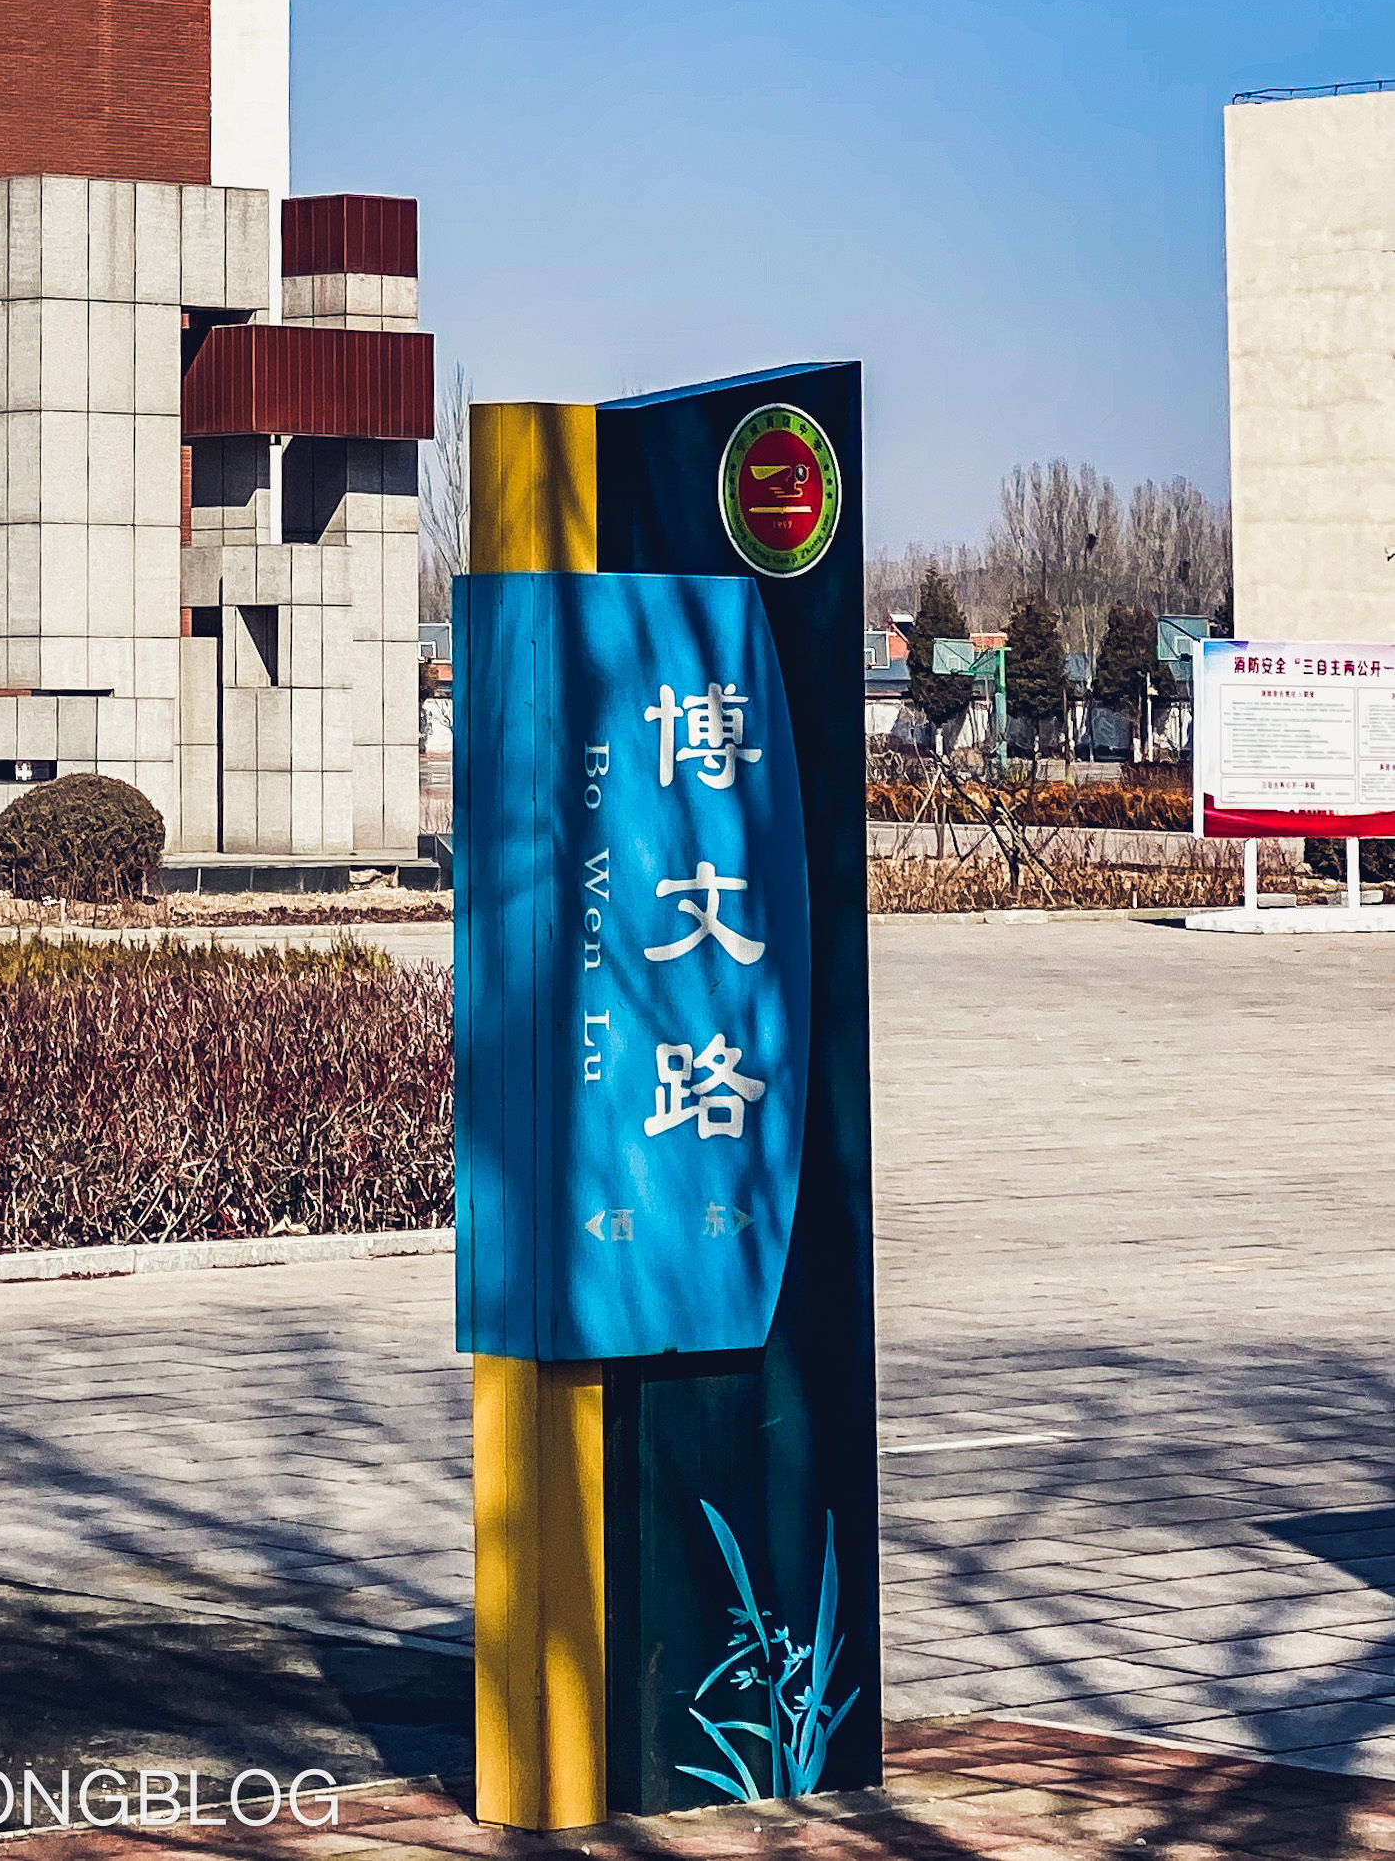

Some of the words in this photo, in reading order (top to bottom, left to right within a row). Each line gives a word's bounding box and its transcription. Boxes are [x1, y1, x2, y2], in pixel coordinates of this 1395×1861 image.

[583, 741, 610, 810] Bo
[583, 847, 610, 972] Wen
[643, 682, 766, 1140] 博文路
[583, 1009, 610, 1085] Lu
